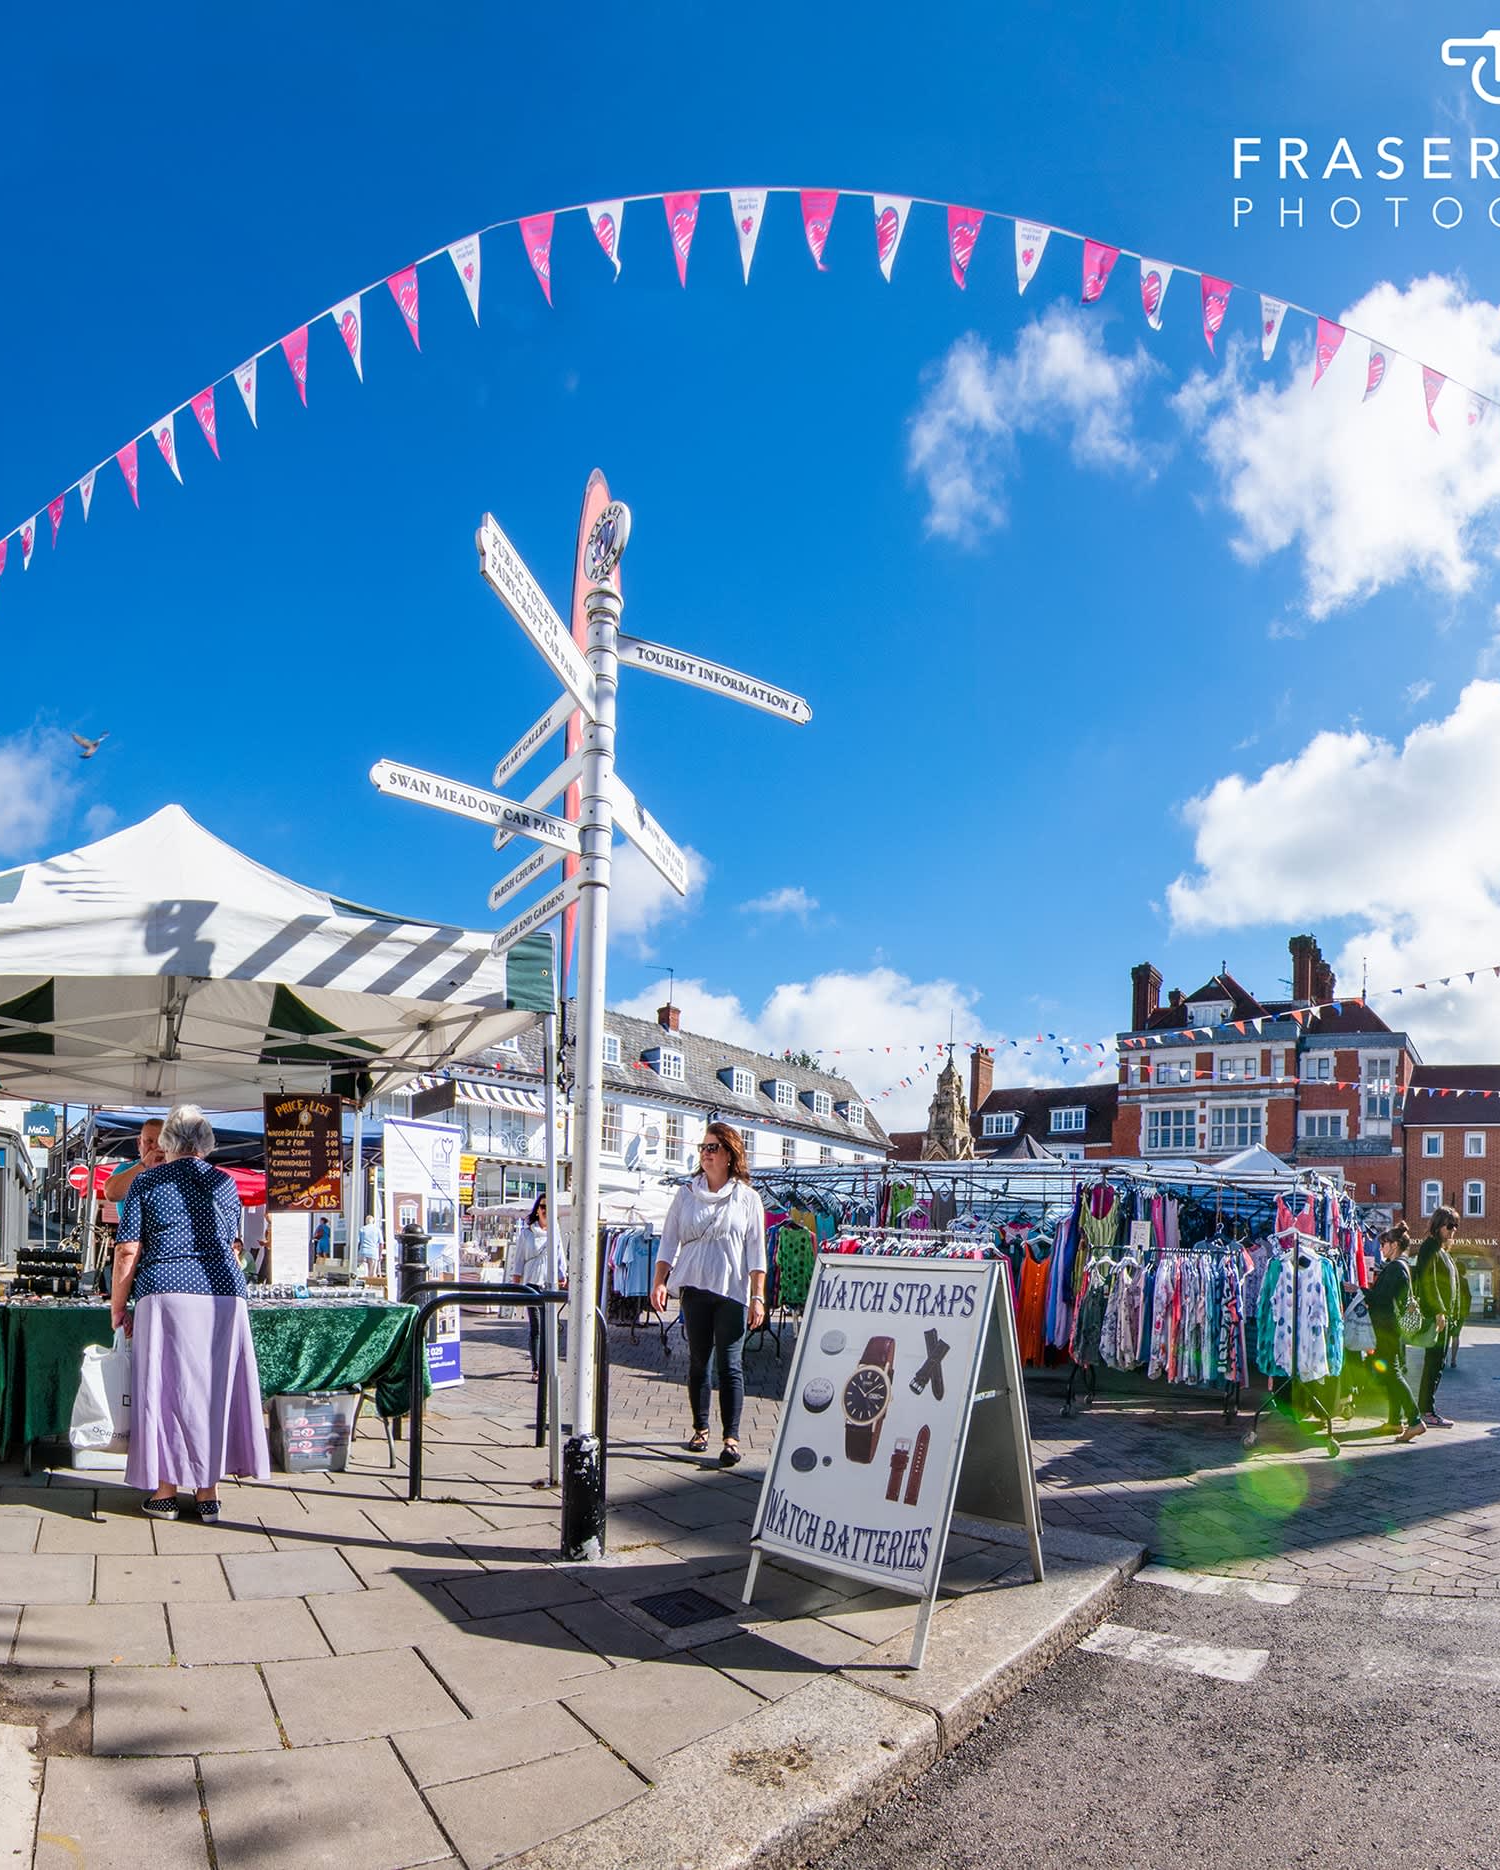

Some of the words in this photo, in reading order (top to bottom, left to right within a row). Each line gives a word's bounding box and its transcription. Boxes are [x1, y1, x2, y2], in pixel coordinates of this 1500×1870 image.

[588, 504, 623, 546] MARKET
[492, 532, 524, 586] PUBLIC
[526, 581, 559, 636] TOILETS
[590, 547, 617, 578] PLACE
[491, 553, 543, 634] FAIRYCROFT
[544, 631, 560, 660] CAR
[560, 655, 579, 686] PARK
[636, 647, 695, 675] TOURIST
[699, 667, 789, 711] INFORMATION
[498, 758, 511, 777] FRY
[510, 746, 523, 763] ART
[523, 715, 553, 752] GALLERY
[389, 771, 431, 795] SWAN
[435, 784, 500, 817] MEADOW
[502, 808, 531, 829] CAR
[532, 818, 566, 841] PARK
[493, 875, 515, 902] PARISH
[515, 854, 545, 883] CHURCH
[496, 921, 518, 948] BRIDGE
[518, 912, 533, 933] END
[532, 890, 565, 921] GARDENS
[275, 1099, 305, 1117] PRICE
[309, 1101, 332, 1118] LIST
[317, 1195, 338, 1208] JLS
[1474, 1238, 1499, 1246] WALK
[818, 1276, 885, 1312] WATCH
[889, 1282, 977, 1318] STRAPS
[765, 1488, 820, 1550] WATCH
[820, 1525, 933, 1572] BATTERIES
